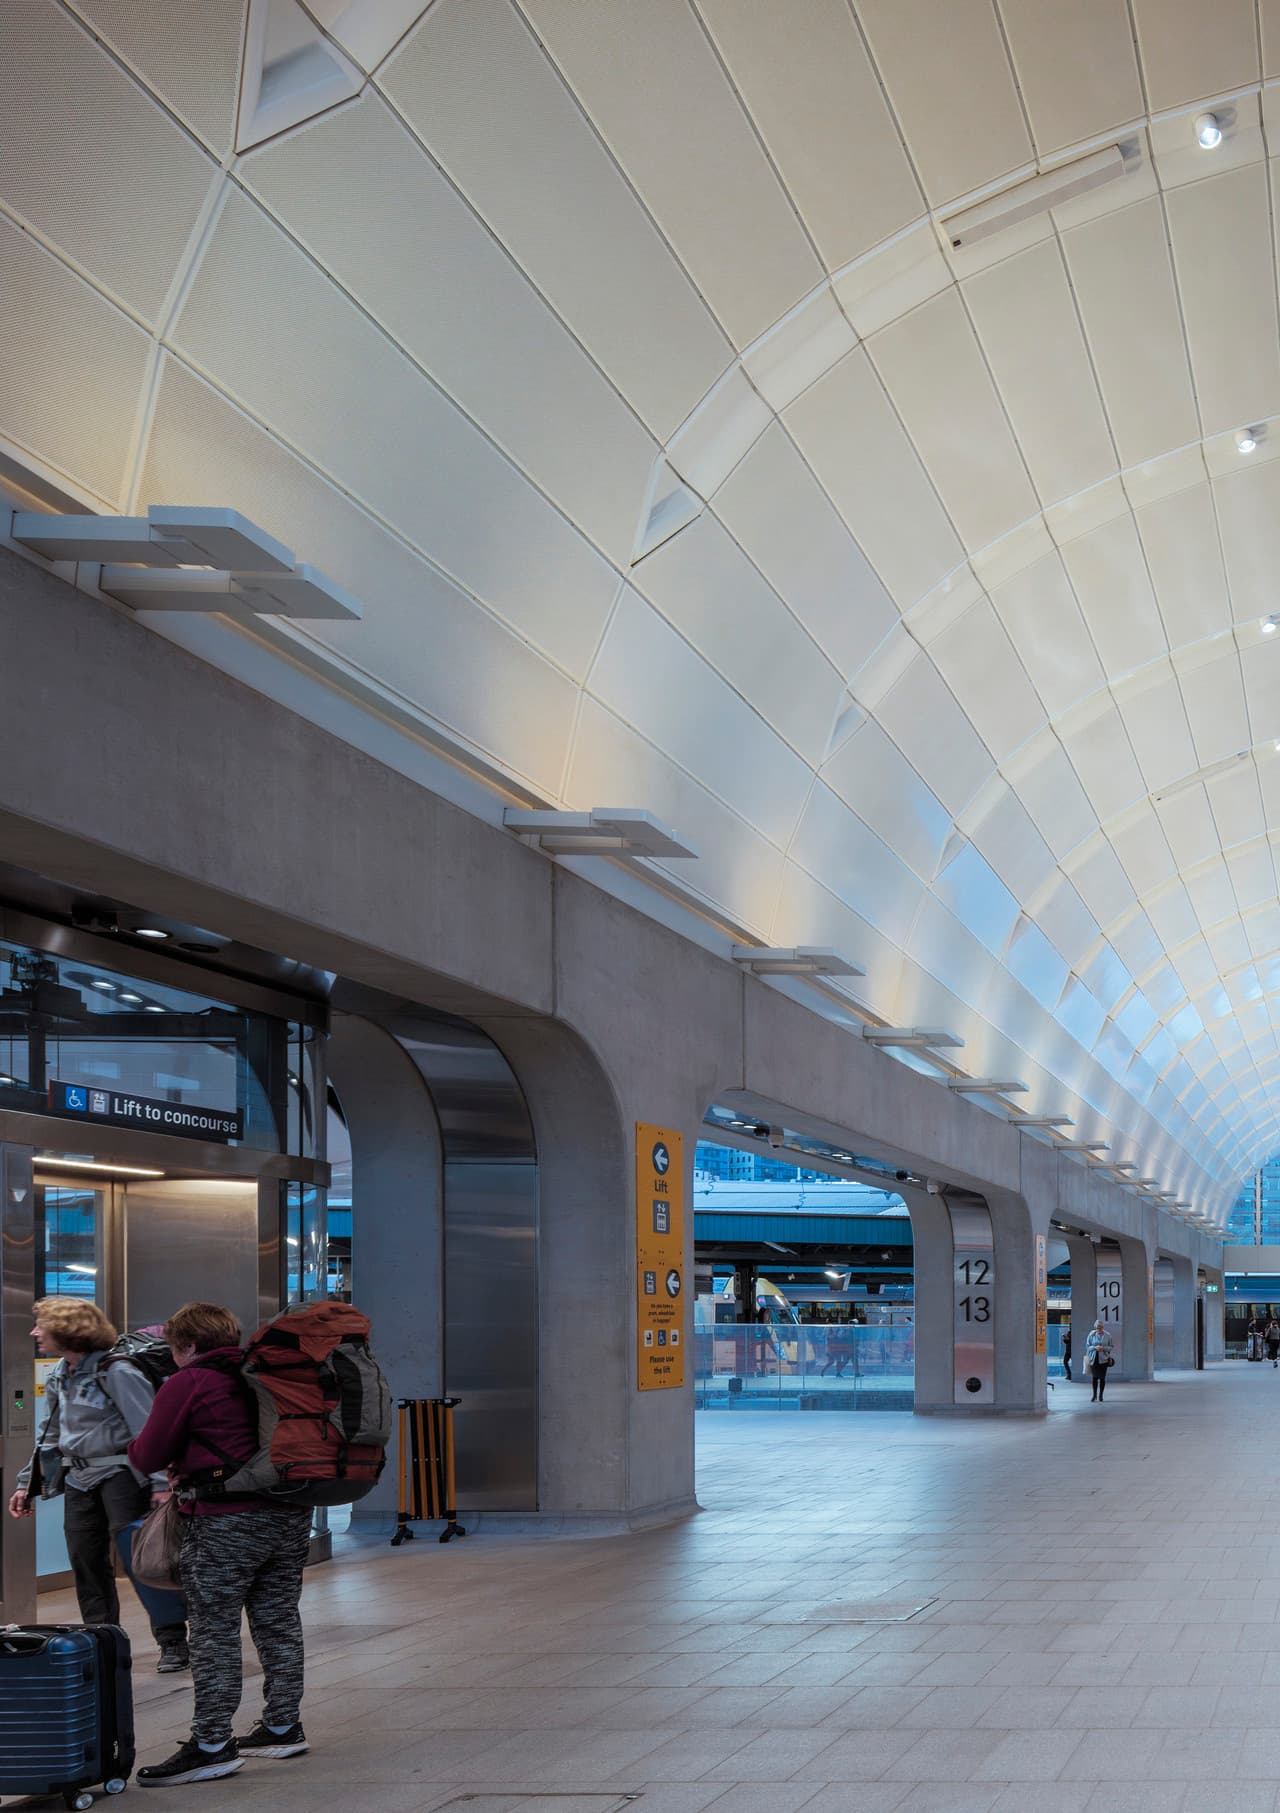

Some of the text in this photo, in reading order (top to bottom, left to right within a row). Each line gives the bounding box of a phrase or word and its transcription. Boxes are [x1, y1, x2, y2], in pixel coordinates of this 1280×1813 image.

[113, 1098, 238, 1133] Lift to concourse
[654, 1179, 669, 1194] Lift
[958, 1259, 990, 1285] 12
[1099, 1281, 1120, 1298] 10
[958, 1296, 990, 1322] 13
[1101, 1304, 1119, 1321] 11
[650, 1355, 665, 1364] Please
[654, 1365, 671, 1374] the lift
